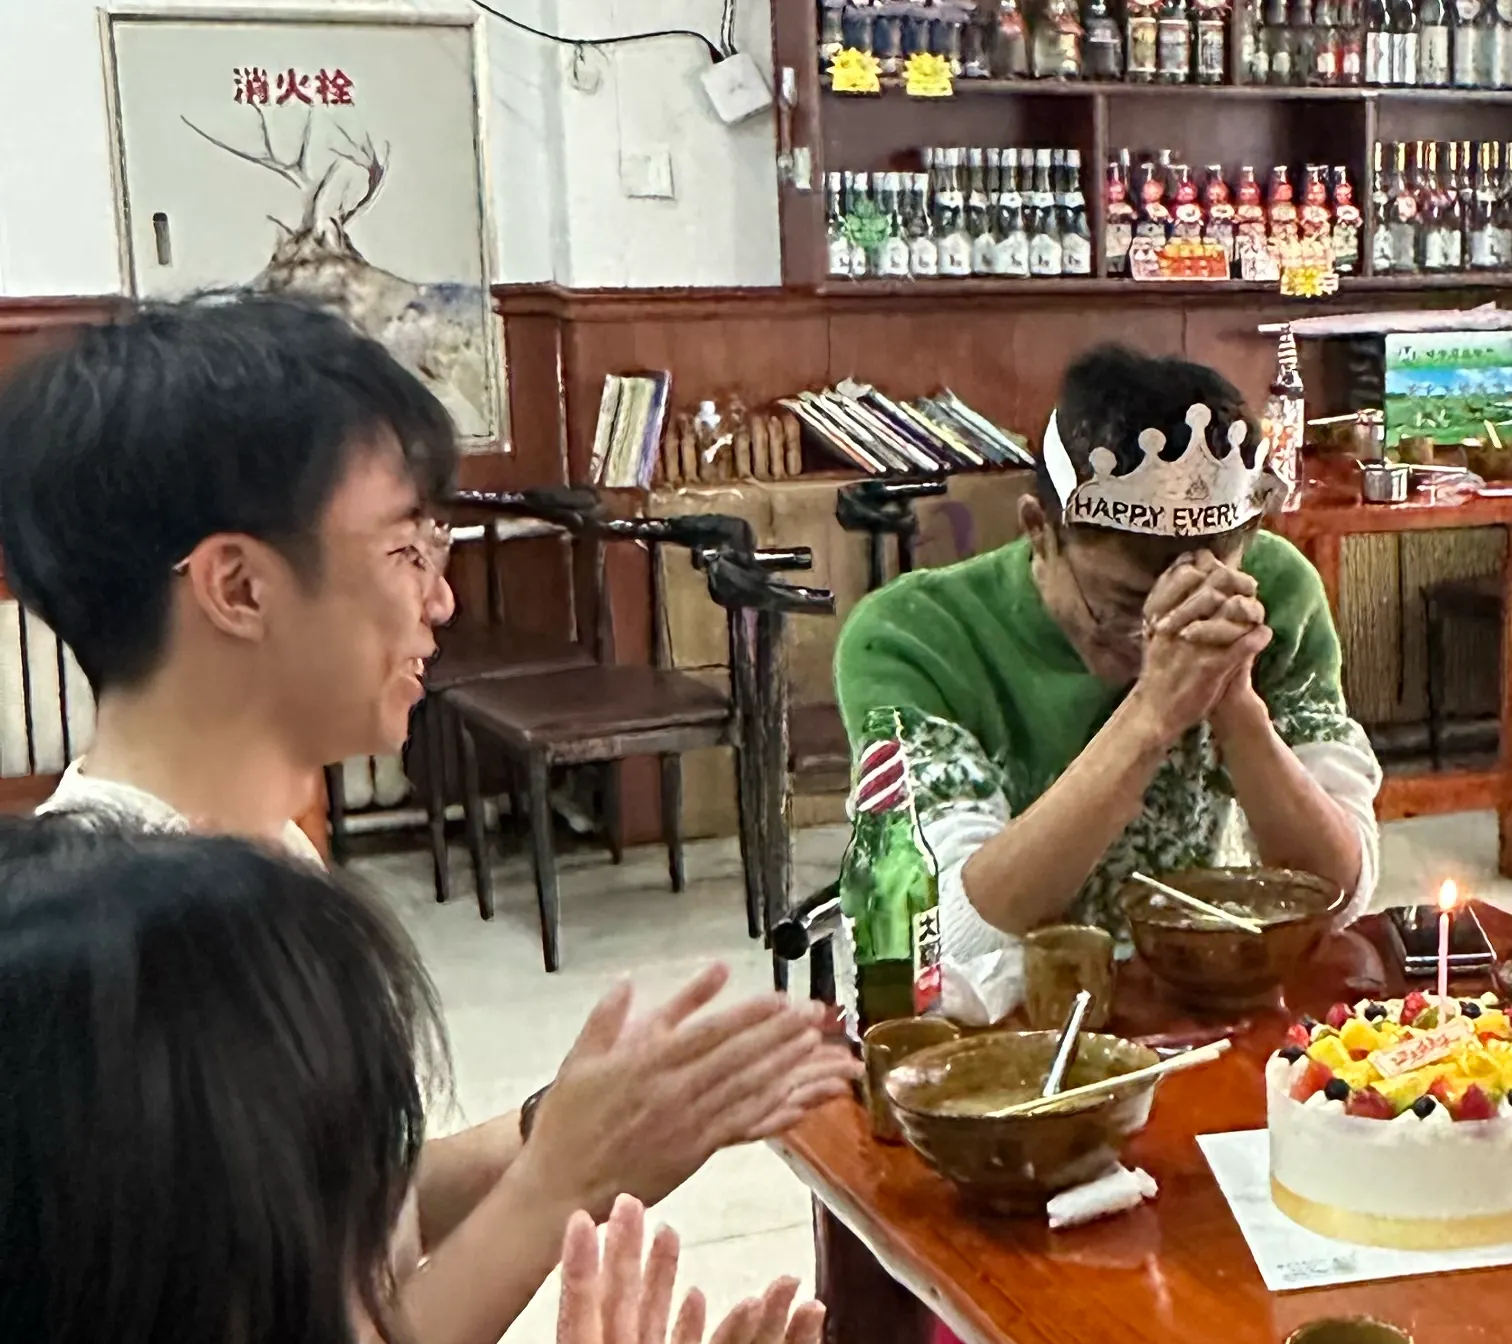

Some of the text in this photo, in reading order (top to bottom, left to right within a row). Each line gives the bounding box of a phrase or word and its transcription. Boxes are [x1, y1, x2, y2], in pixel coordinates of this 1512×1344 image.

[233, 66, 356, 107] 消火栓
[1074, 493, 1166, 528] HAPPY
